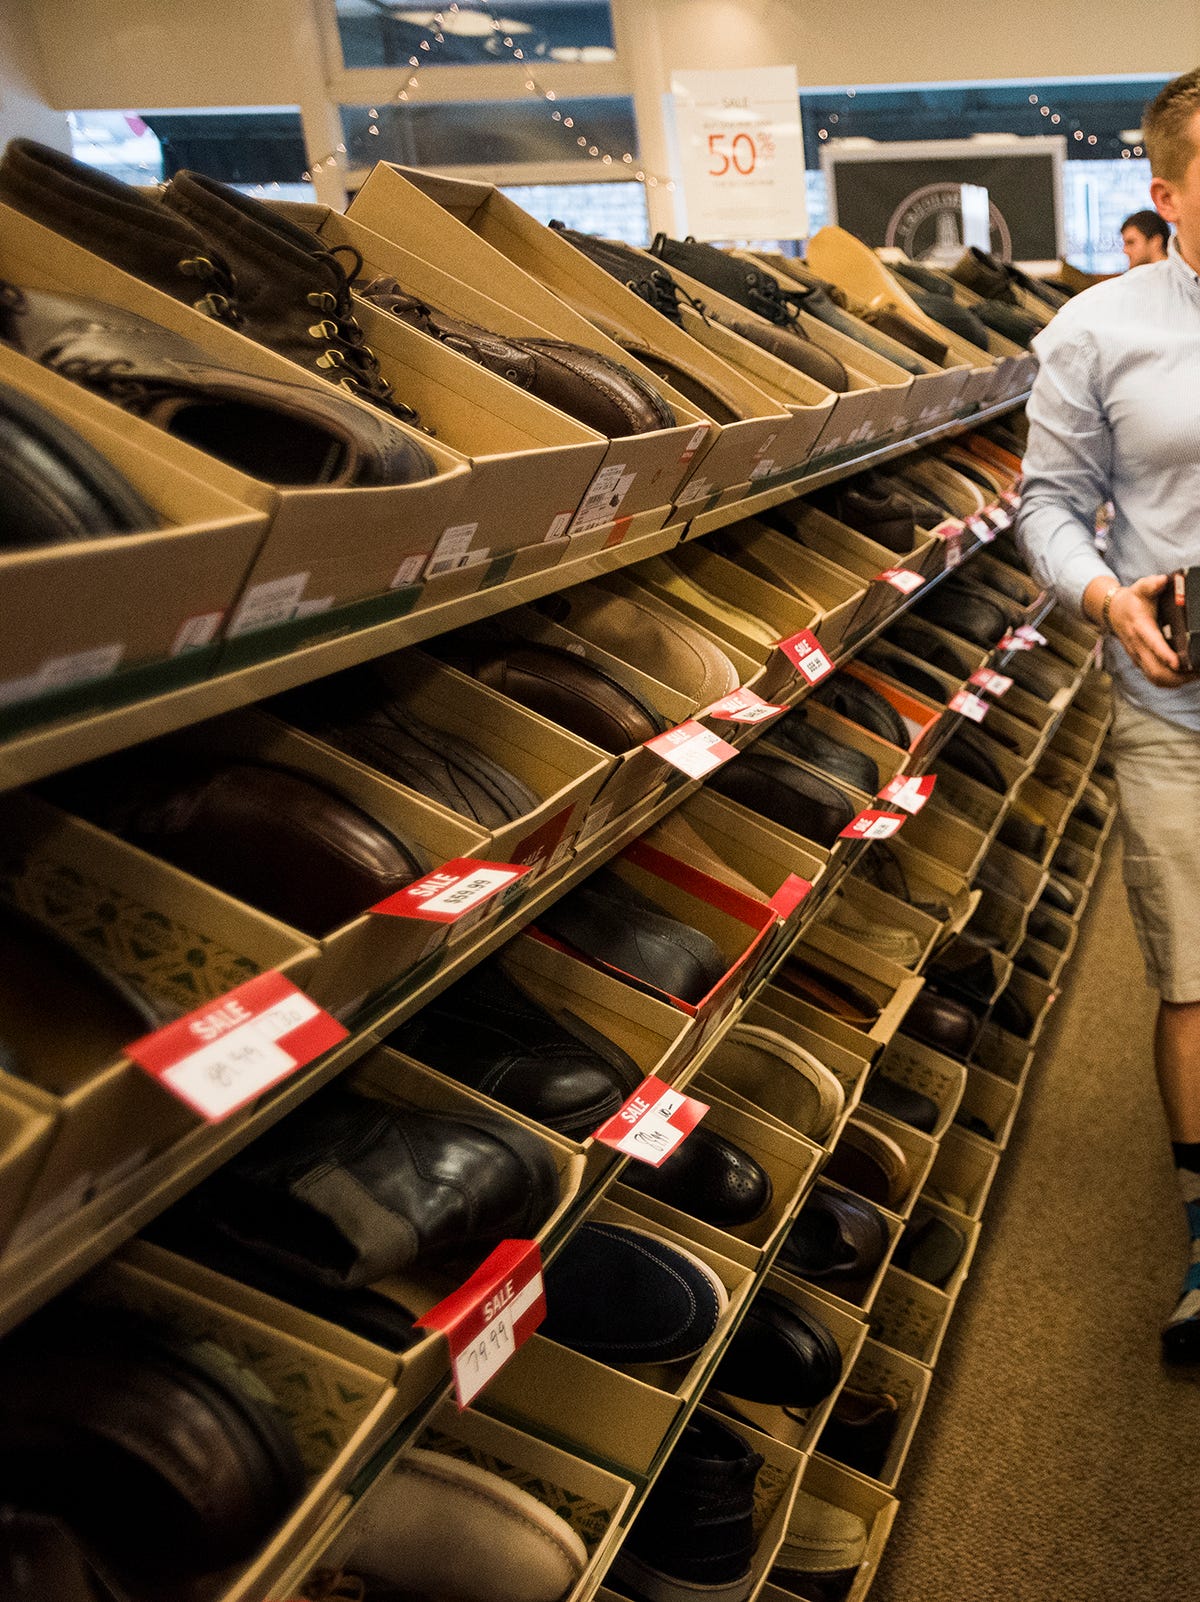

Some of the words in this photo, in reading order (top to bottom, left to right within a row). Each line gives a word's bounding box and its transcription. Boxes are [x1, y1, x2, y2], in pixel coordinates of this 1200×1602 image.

[408, 873, 461, 898] SALE
[443, 879, 493, 905] $59.99
[190, 1000, 252, 1041] SALE
[620, 1096, 651, 1124] SALE
[482, 1278, 517, 1323] SALE
